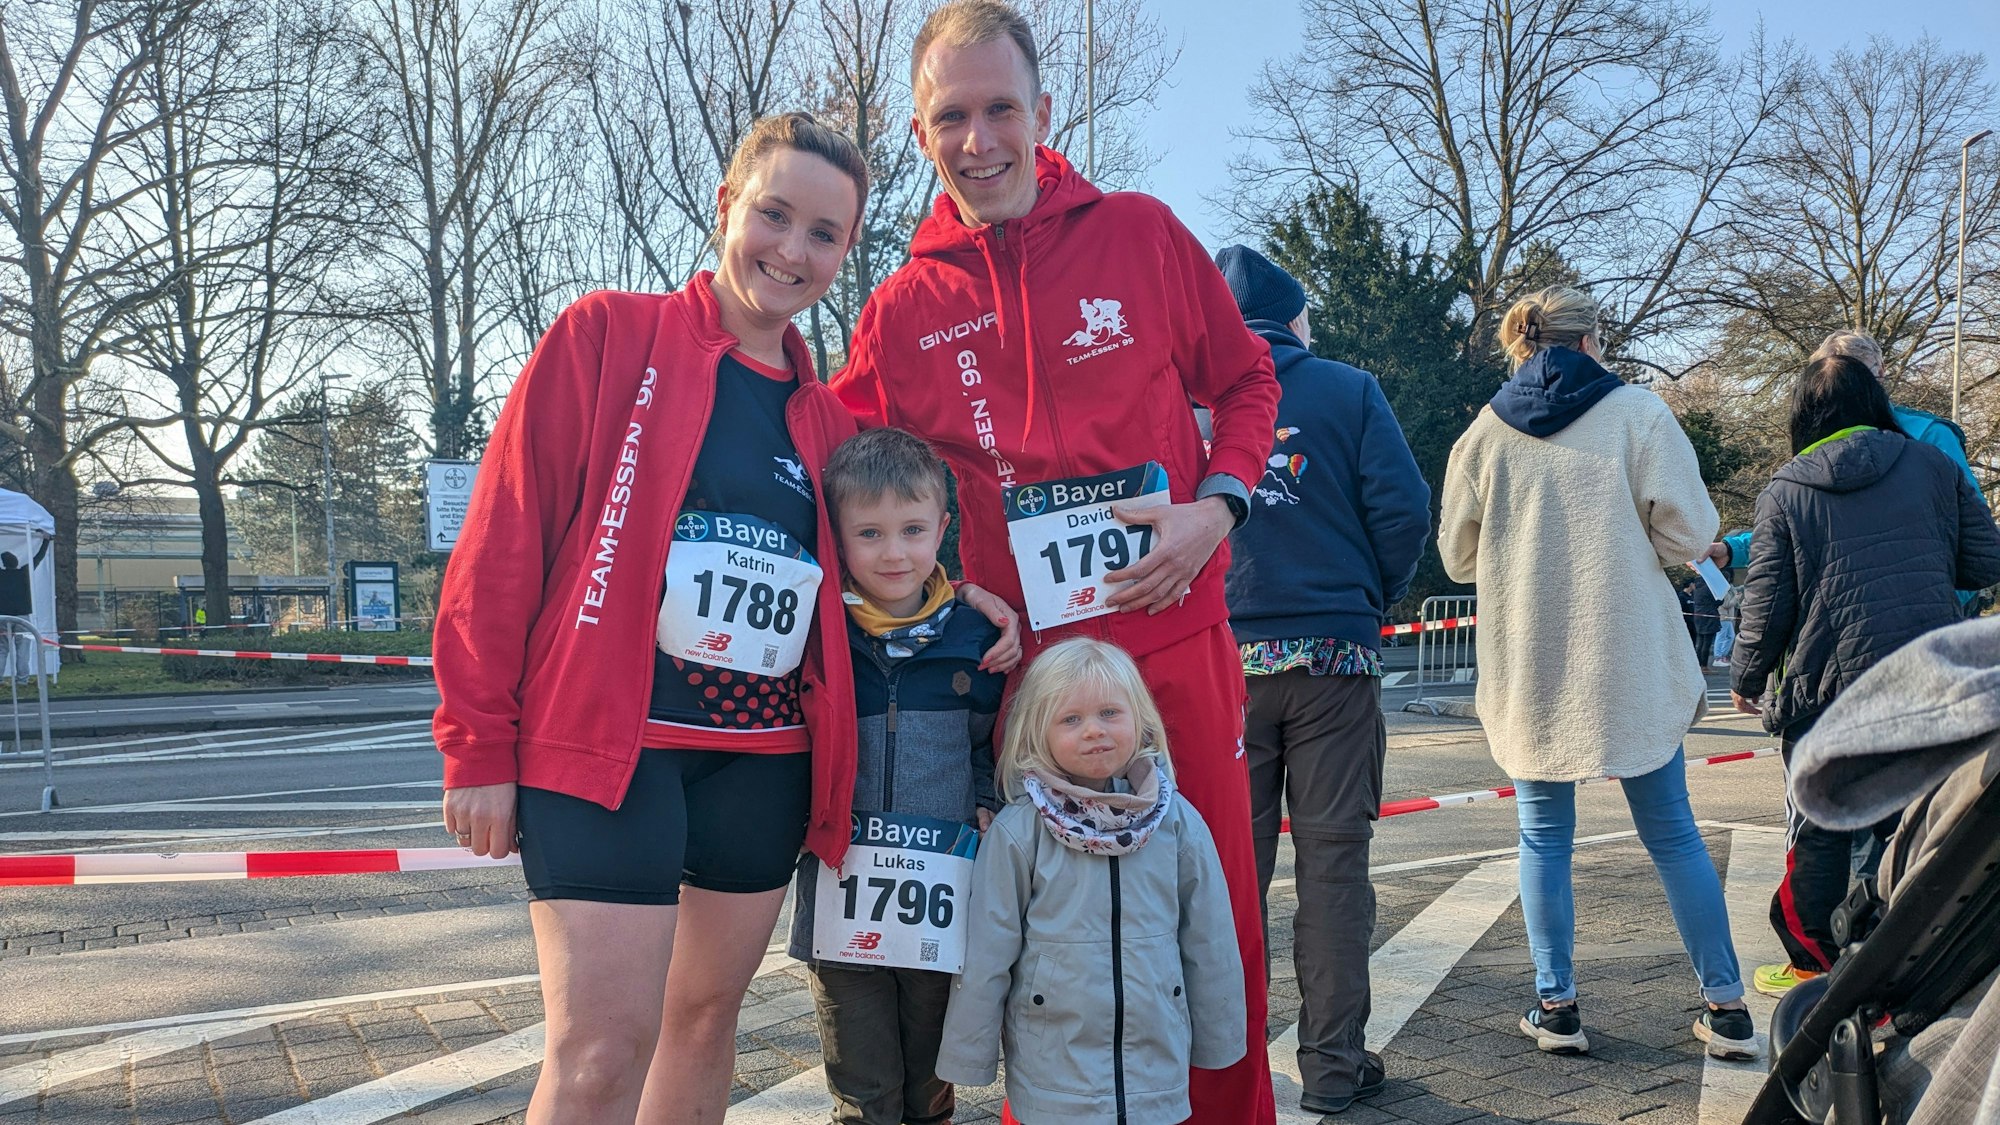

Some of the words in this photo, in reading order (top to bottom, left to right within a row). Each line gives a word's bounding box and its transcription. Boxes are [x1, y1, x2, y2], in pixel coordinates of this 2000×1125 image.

[918, 311, 998, 351] GIVOVA
[1020, 495, 1044, 506] BAYER
[1051, 479, 1126, 506] Bayer
[574, 421, 644, 630] TEAM-ESSEN
[1066, 505, 1115, 529] David
[714, 516, 788, 551] Bayer
[727, 549, 775, 575] Katrin
[1039, 524, 1153, 584] 1797
[693, 569, 799, 636] 1788
[1060, 610, 1075, 620] new
[1076, 603, 1105, 616] balance
[684, 648, 702, 657] new
[702, 649, 734, 664] balance
[867, 816, 942, 848] Bayer
[873, 852, 925, 871] Lukas
[838, 874, 955, 929] 1796
[855, 951, 886, 961] balance
